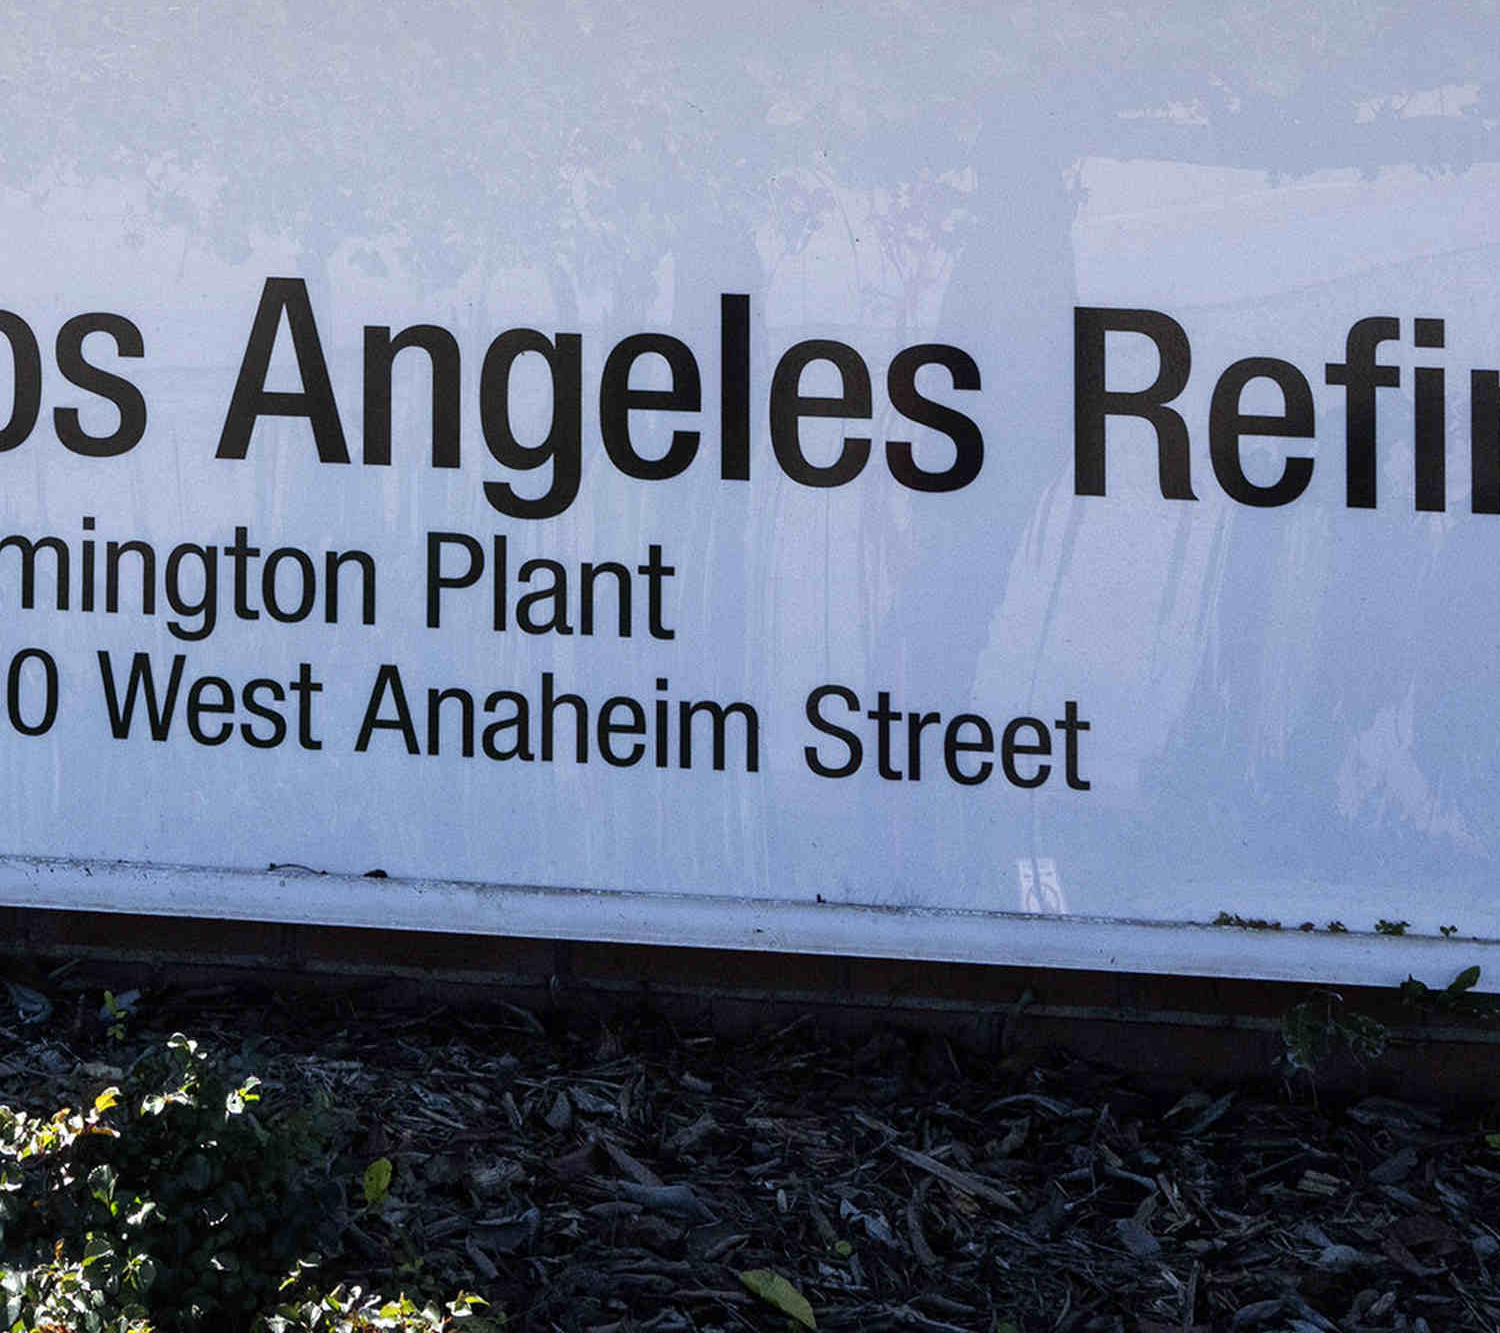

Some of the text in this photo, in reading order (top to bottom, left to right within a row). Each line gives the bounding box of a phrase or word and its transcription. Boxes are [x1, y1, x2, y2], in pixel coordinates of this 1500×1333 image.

[214, 275, 986, 521] Angeles
[425, 530, 677, 642] Plant
[95, 649, 324, 752] West
[353, 663, 761, 774] Anaheim
[803, 683, 1092, 792] Street
